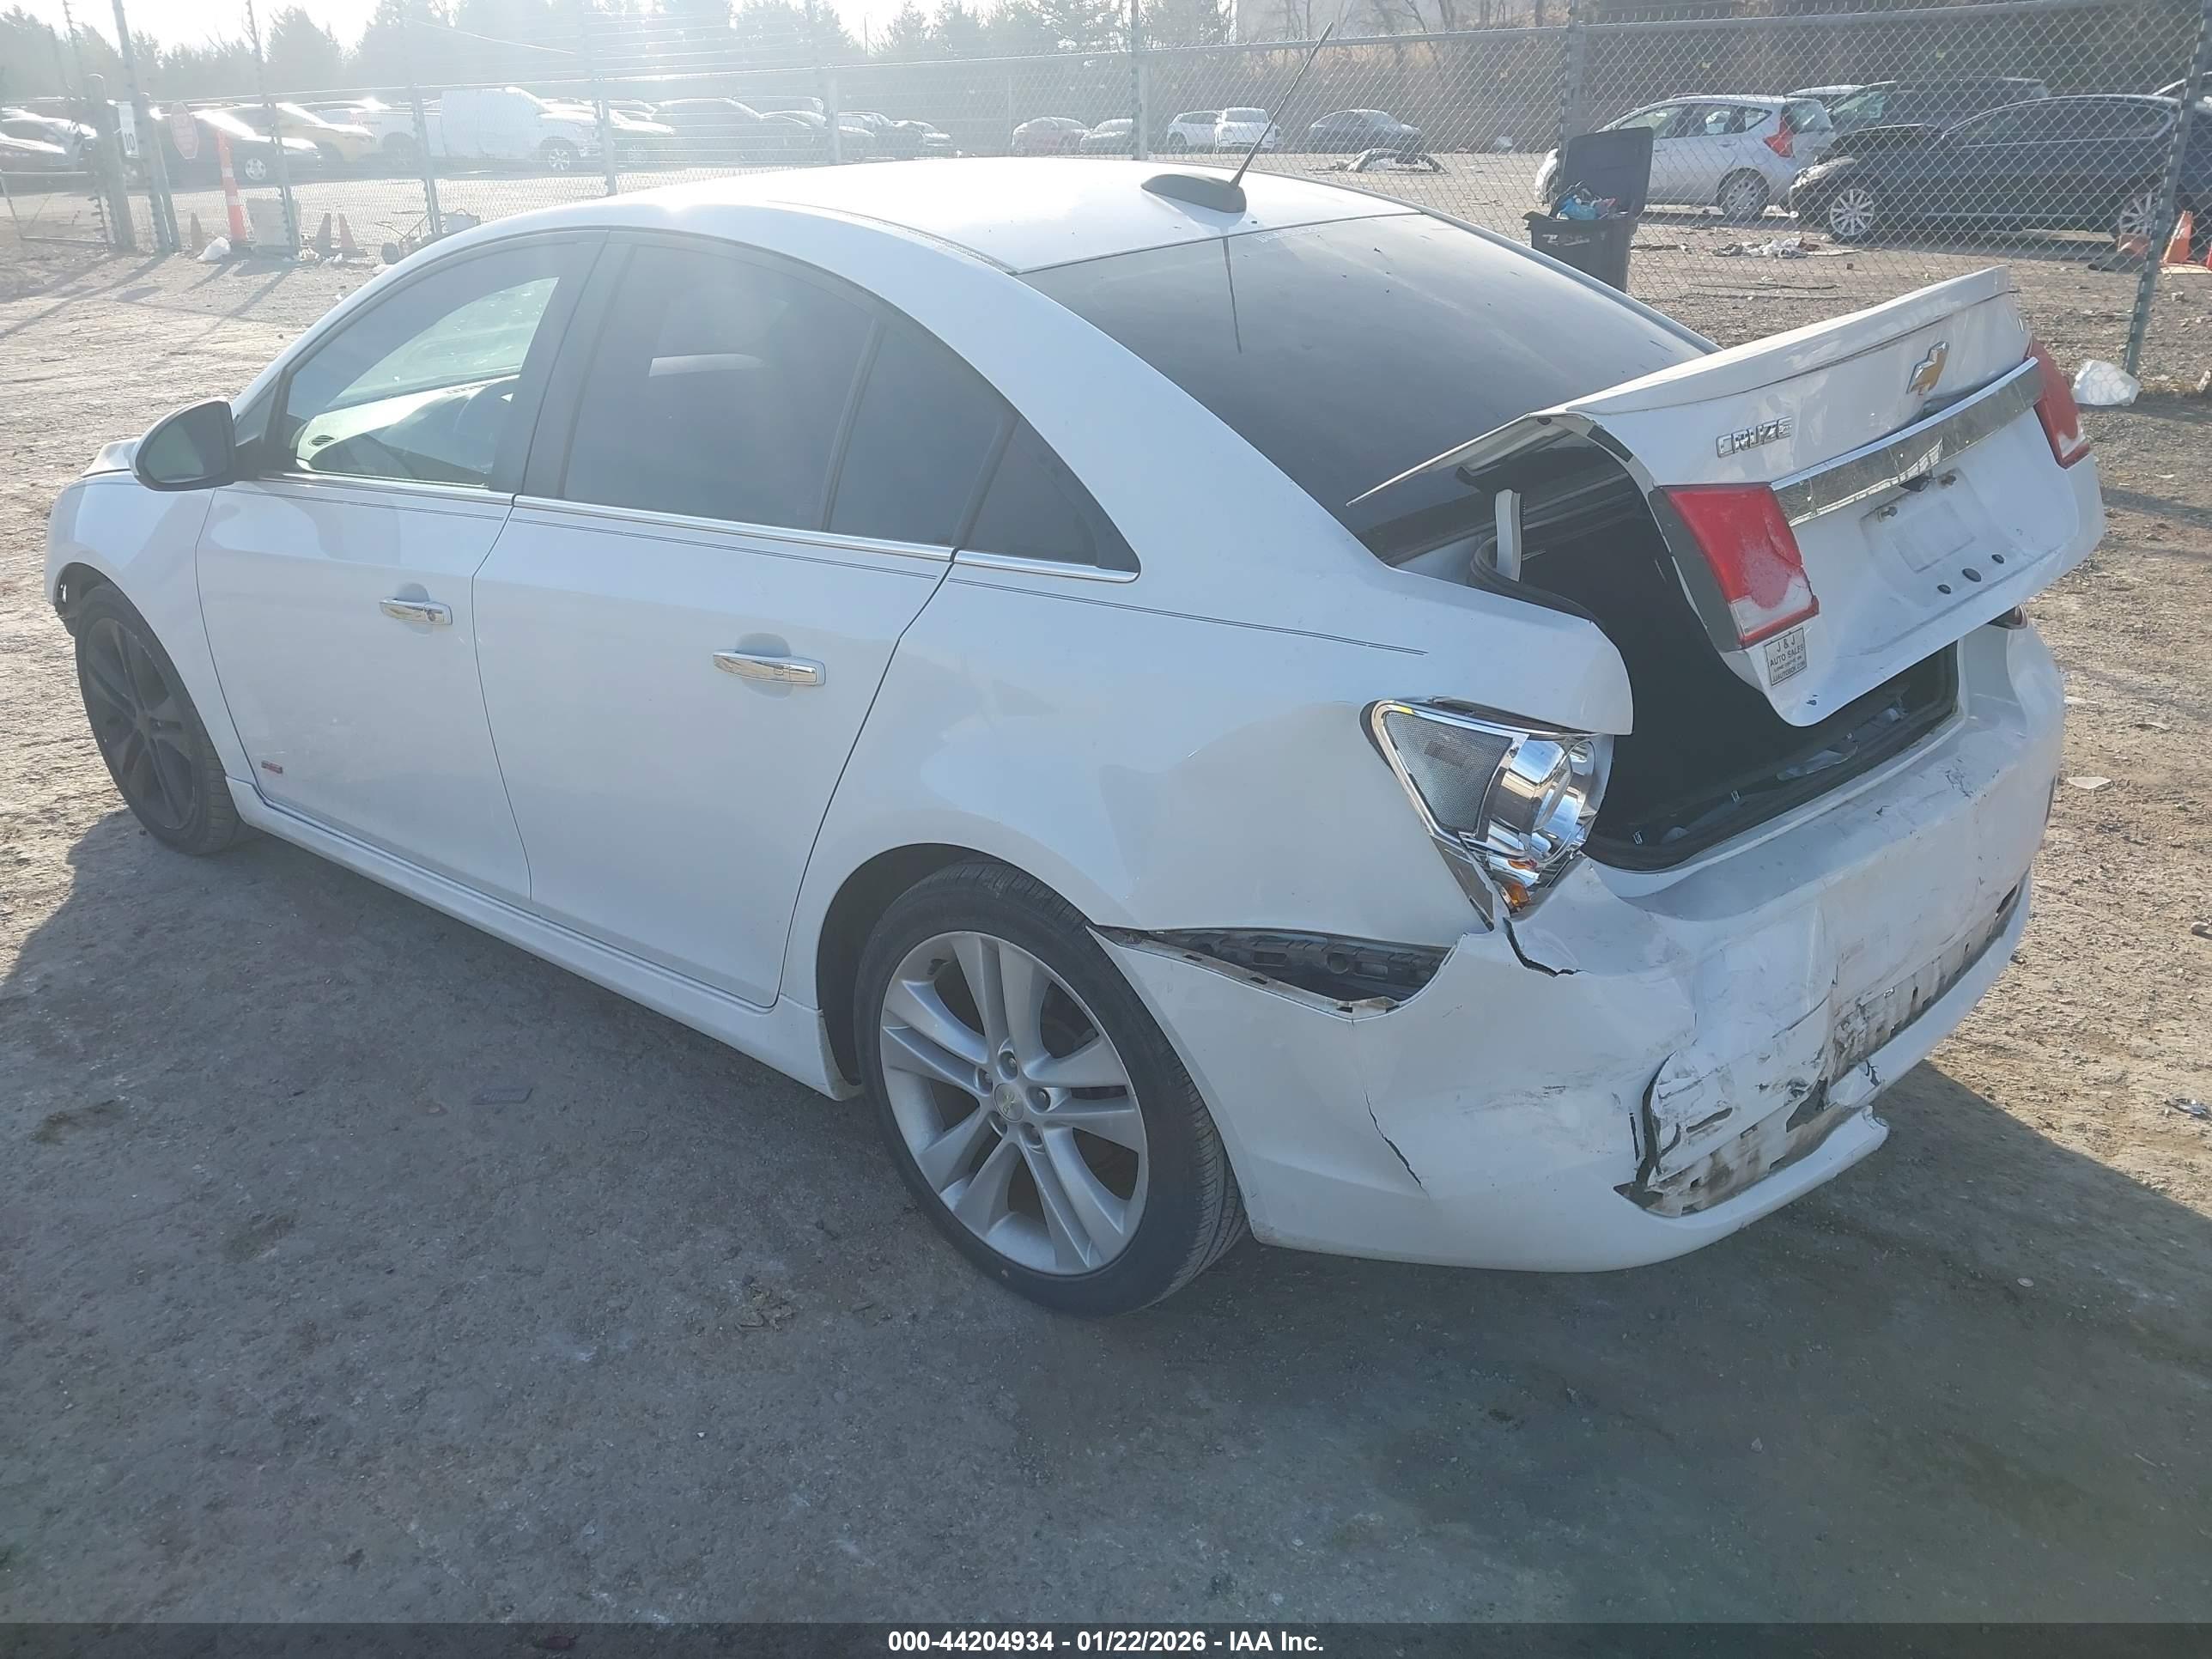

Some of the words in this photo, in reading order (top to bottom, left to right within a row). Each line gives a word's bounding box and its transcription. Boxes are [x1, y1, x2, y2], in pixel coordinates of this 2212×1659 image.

[125, 132, 136, 151] 10
[1717, 416, 1792, 458] CRUZE
[1777, 641, 1781, 653] J
[1784, 638, 1789, 649] &
[1791, 635, 1796, 646] J
[1770, 653, 1786, 666] AUTO
[1788, 644, 1804, 658] SALES
